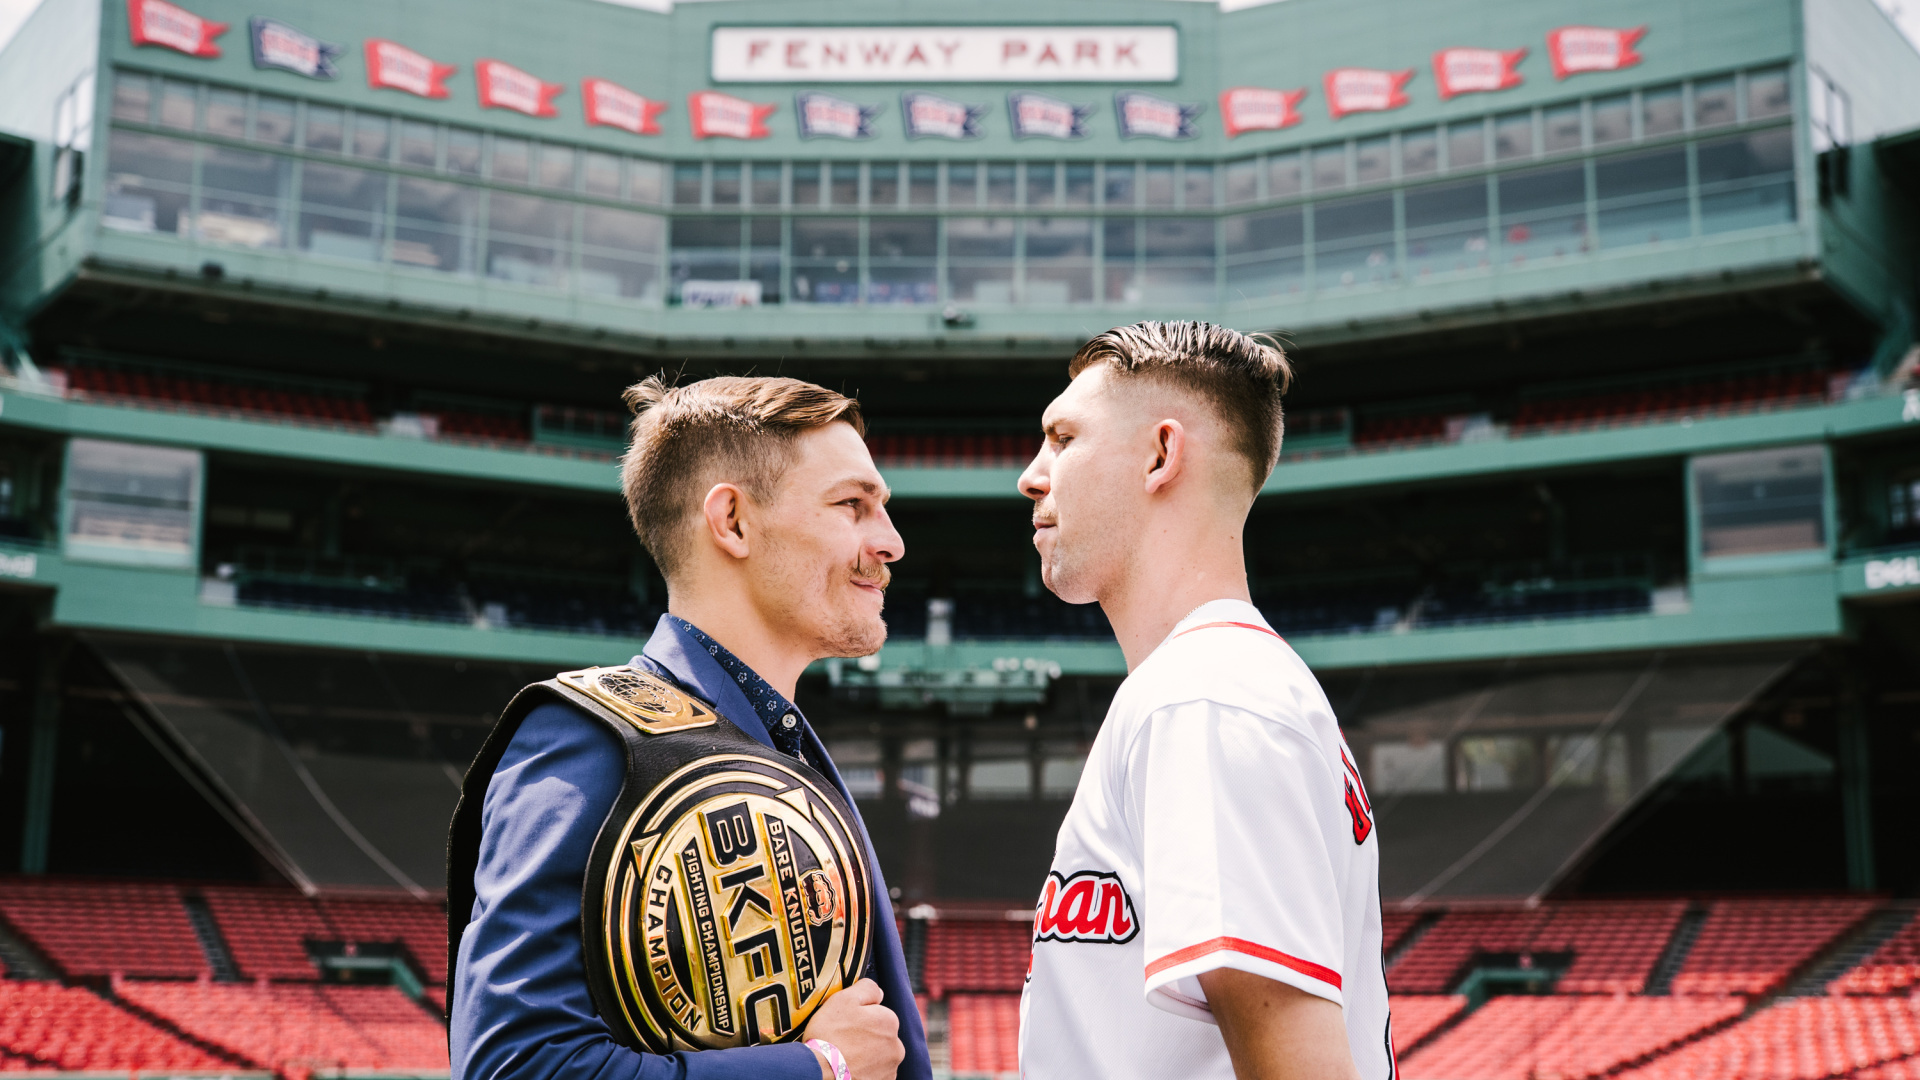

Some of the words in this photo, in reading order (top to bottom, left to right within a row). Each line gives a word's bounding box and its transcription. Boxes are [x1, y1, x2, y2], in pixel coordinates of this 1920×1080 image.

[745, 40, 961, 68] FENWAY
[1001, 40, 1140, 68] PARK
[647, 864, 703, 1032] CHAMPION
[684, 848, 711, 917] FIGHTING
[701, 920, 731, 1030] CHAMPIONSHIP
[703, 800, 793, 1046] BKFC
[768, 820, 793, 882] BARE
[783, 887, 814, 994] KNUCKLE
